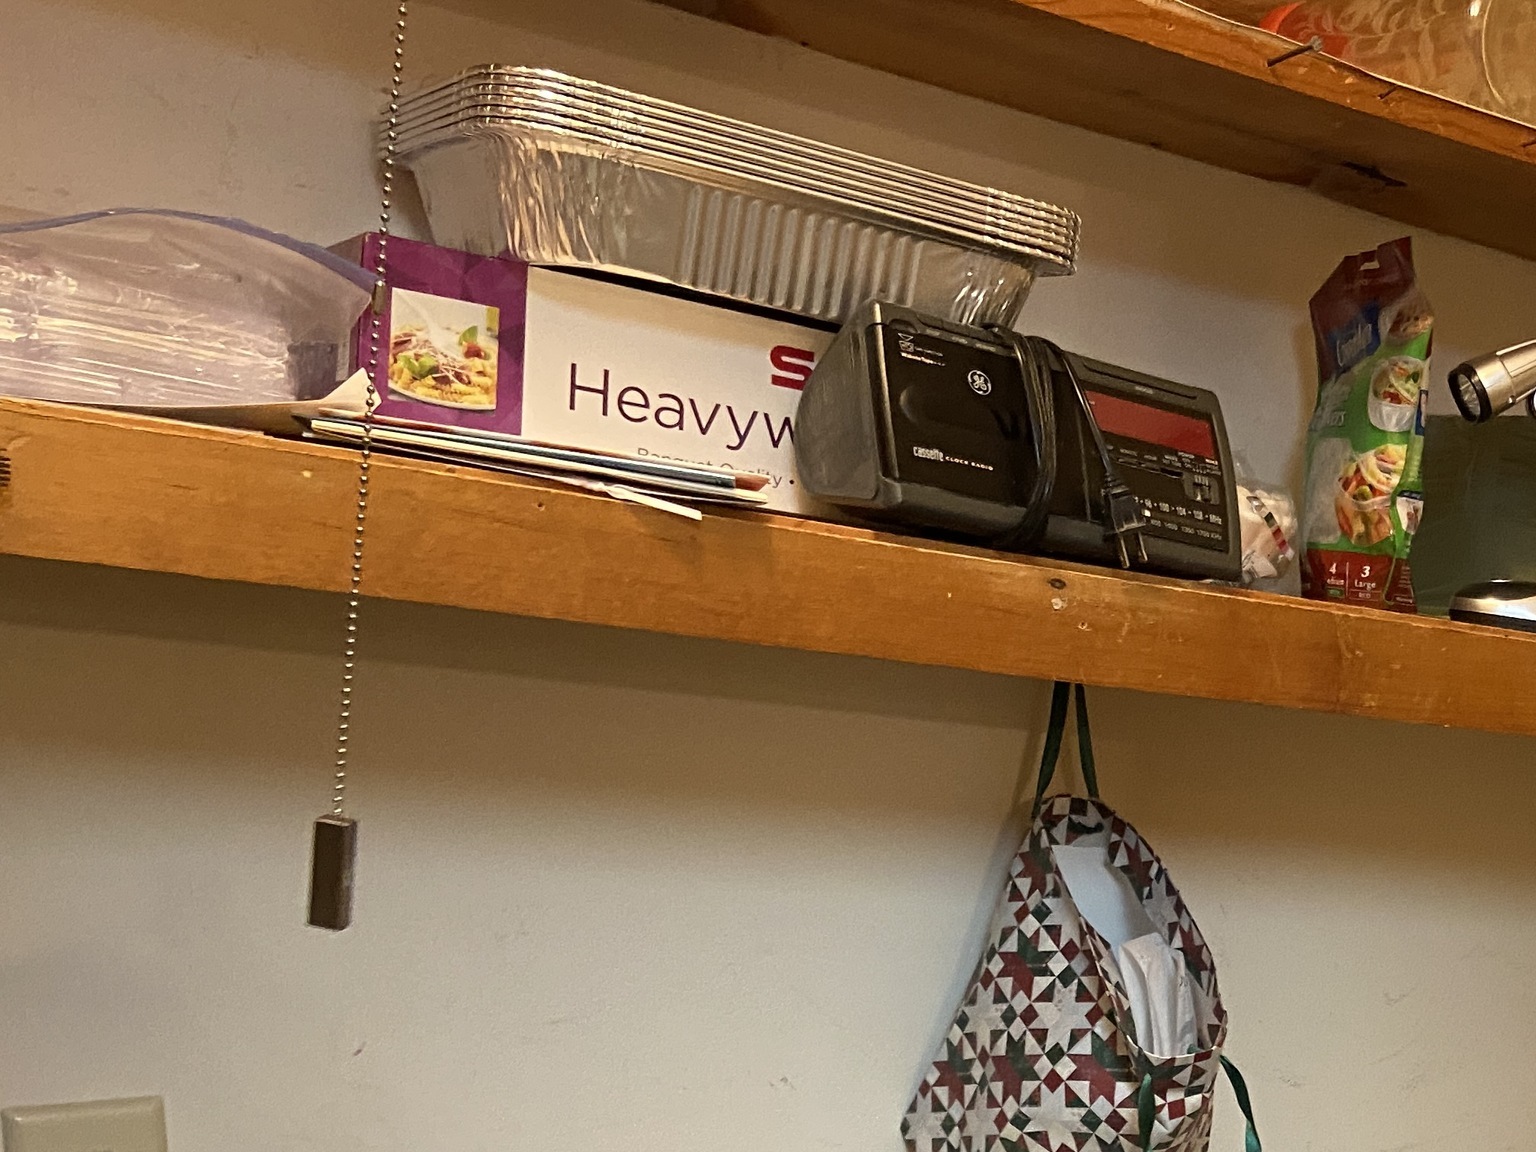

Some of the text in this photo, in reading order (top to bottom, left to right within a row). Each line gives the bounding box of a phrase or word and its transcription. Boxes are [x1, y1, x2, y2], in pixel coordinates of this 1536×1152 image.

[1329, 563, 1337, 574] 4
[1361, 565, 1371, 578] 3
[1354, 579, 1377, 591] Large
